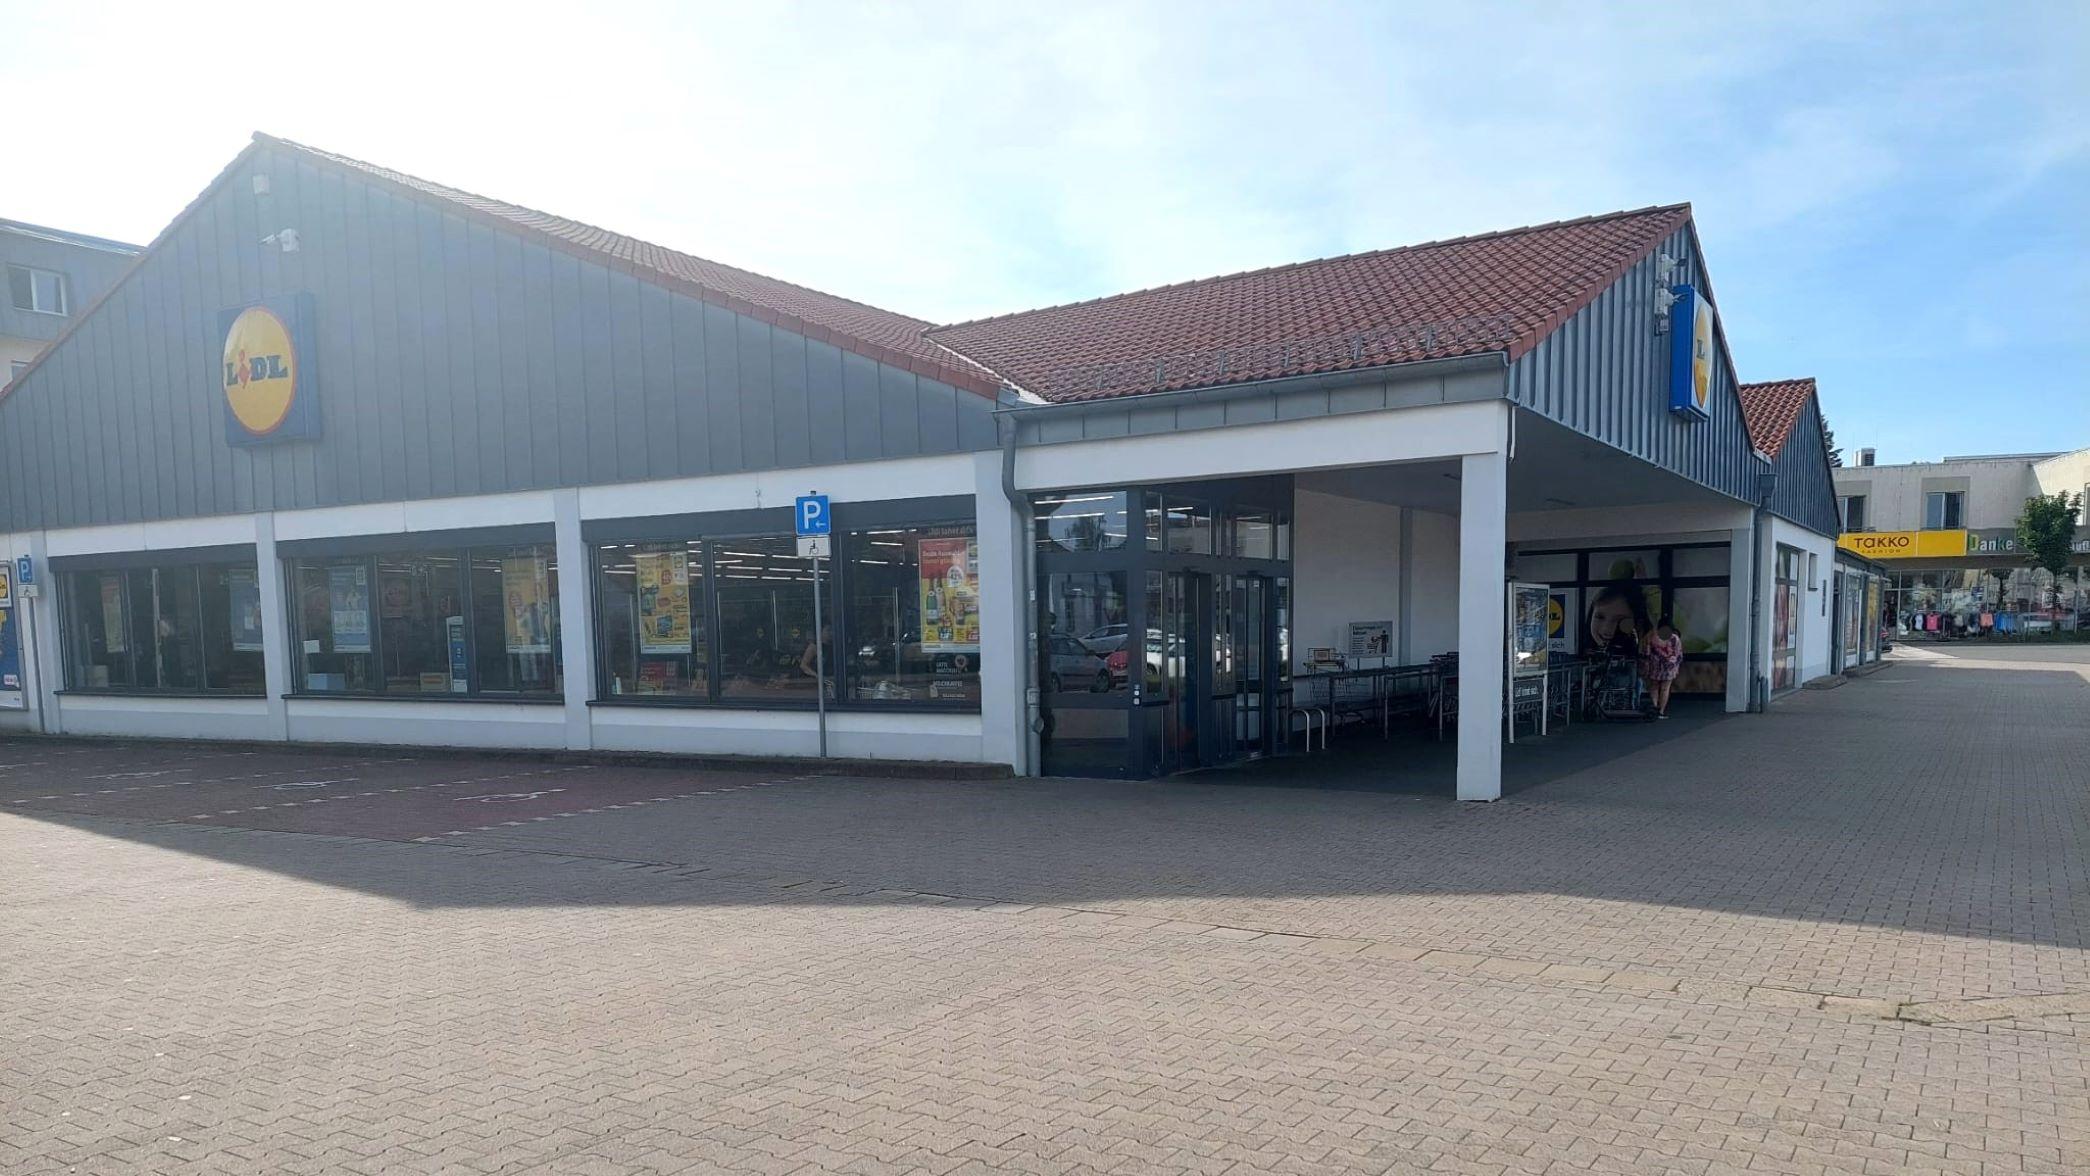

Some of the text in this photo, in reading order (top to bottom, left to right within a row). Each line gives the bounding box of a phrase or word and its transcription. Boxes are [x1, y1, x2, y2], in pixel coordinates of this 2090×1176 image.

[226, 350, 288, 389] LIDL
[803, 501, 821, 529] P
[1968, 534, 2014, 551] Danke
[21, 561, 30, 580] P
